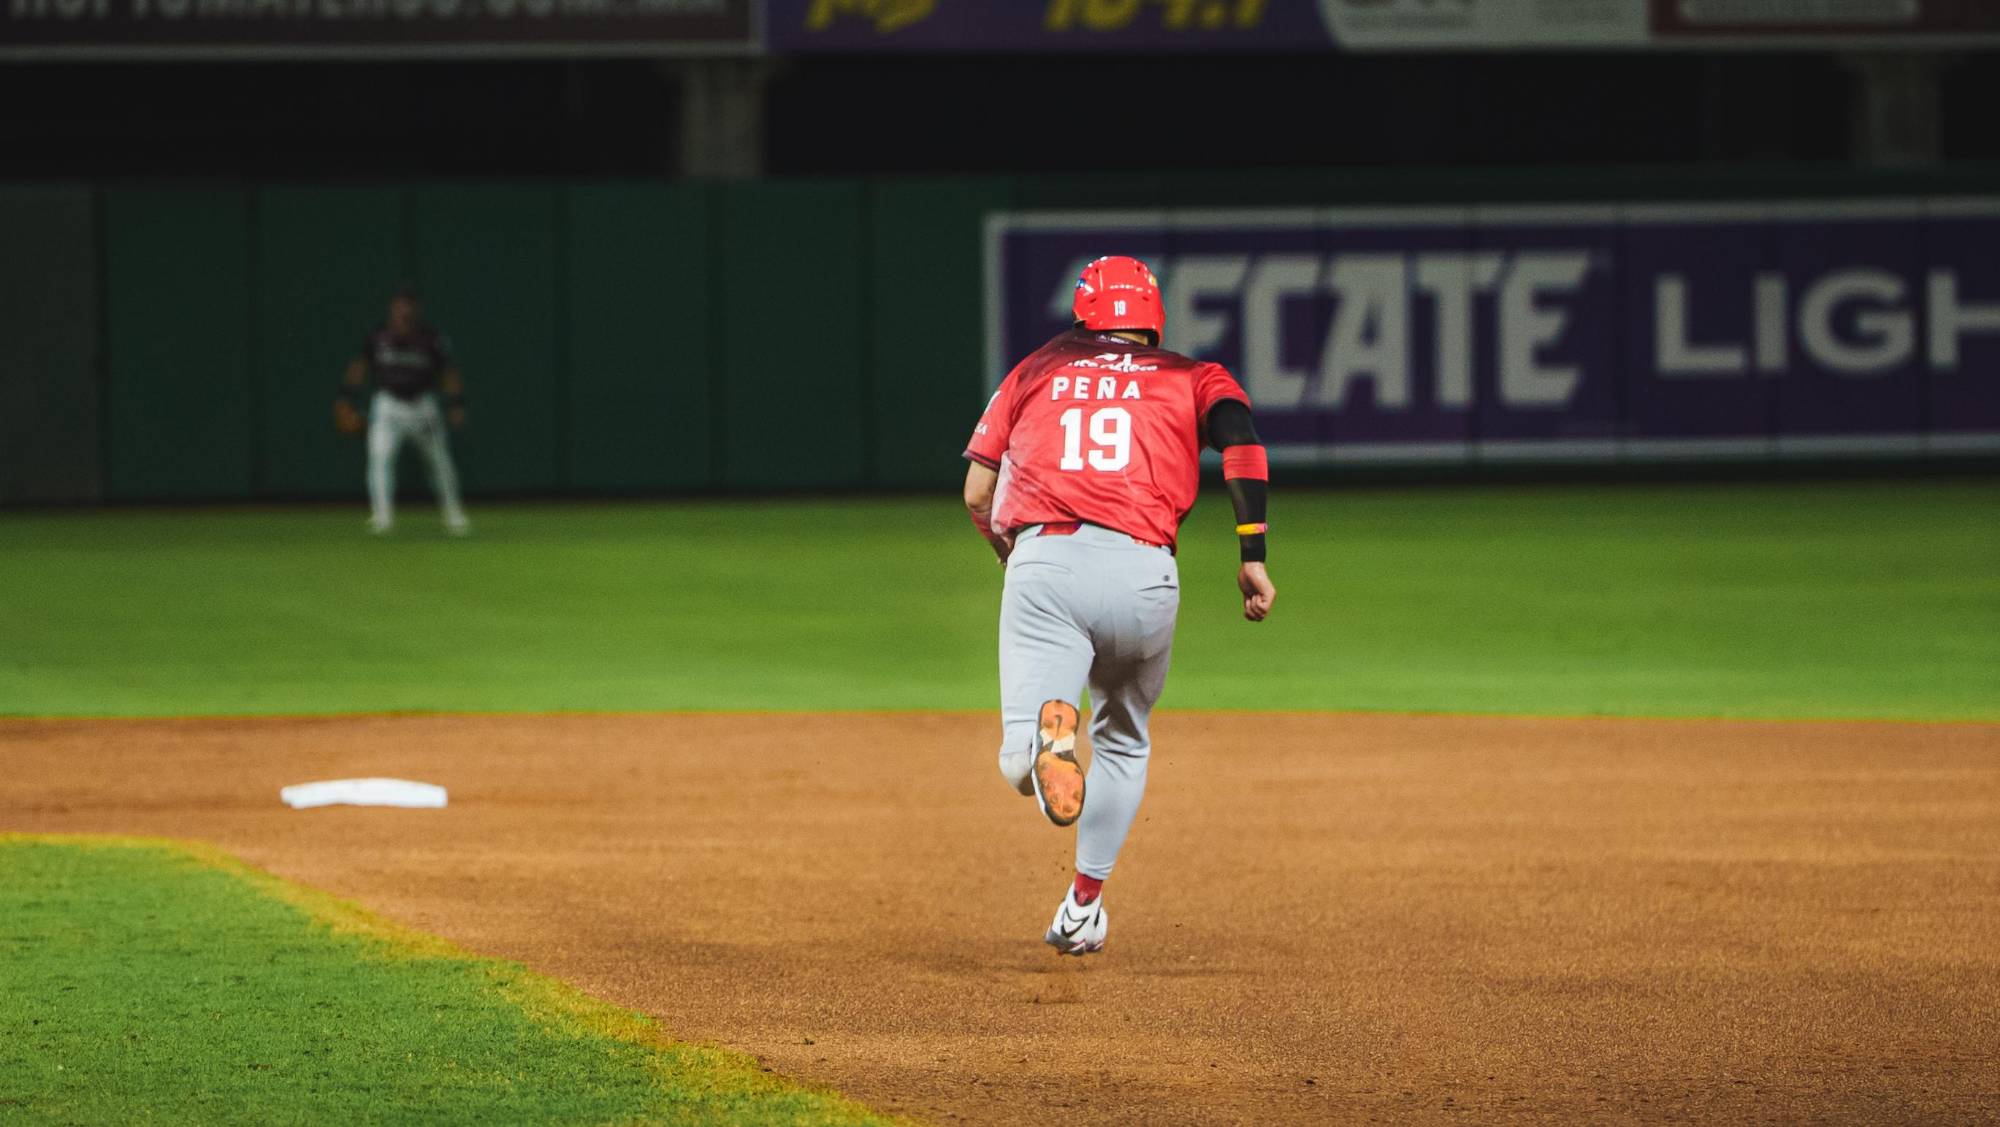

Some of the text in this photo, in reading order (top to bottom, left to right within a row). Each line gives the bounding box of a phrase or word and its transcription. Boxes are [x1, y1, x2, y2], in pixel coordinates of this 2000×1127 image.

[1050, 250, 1588, 408] ECATE
[1050, 375, 1142, 402] PEÑA
[1058, 406, 1133, 473] 19
